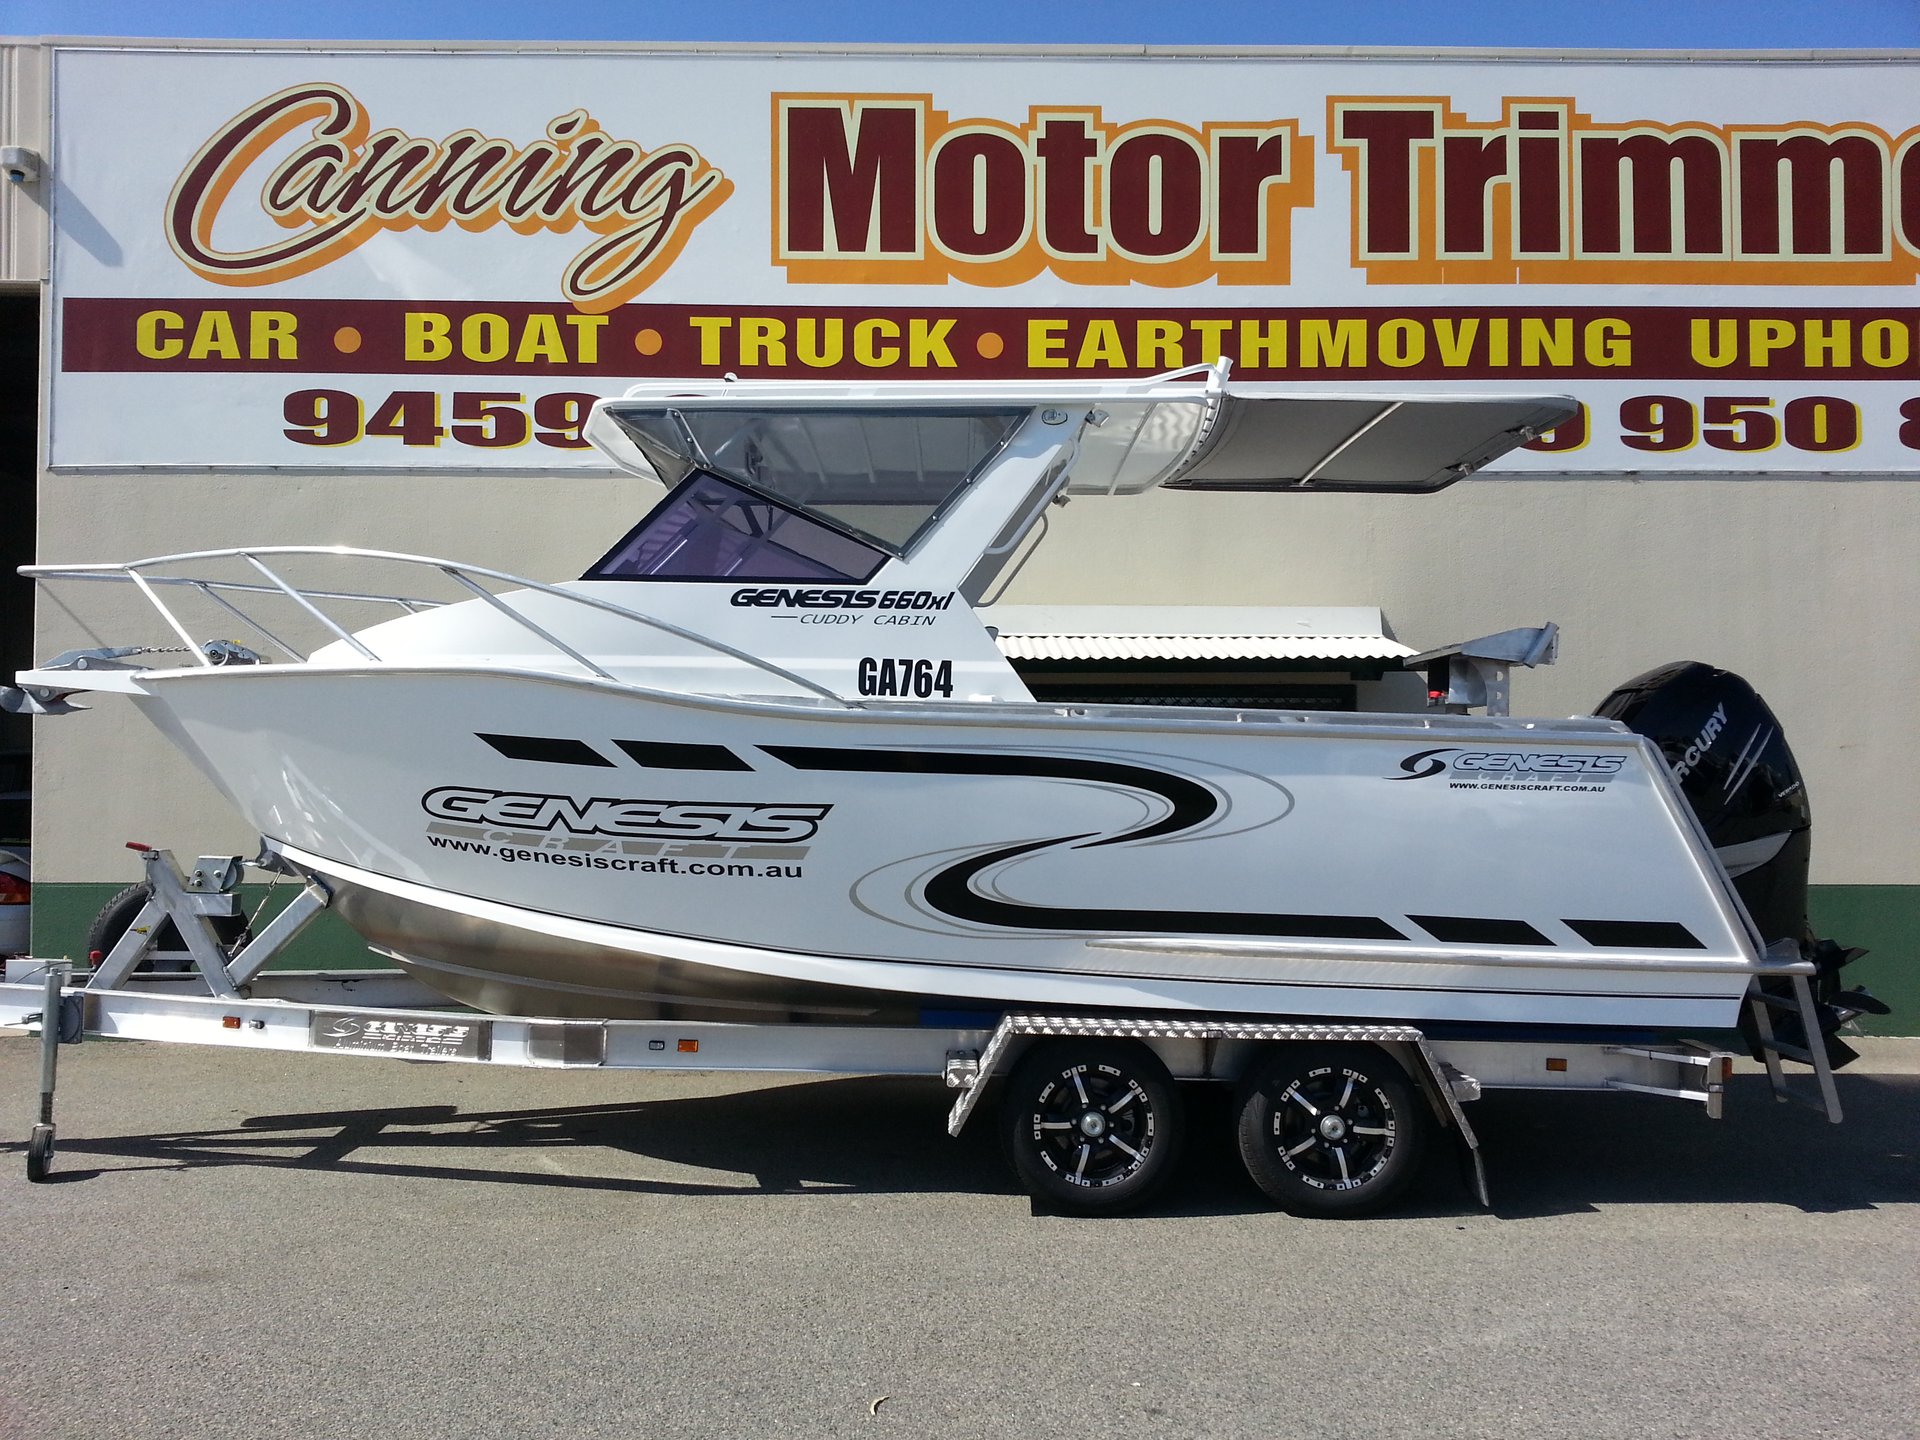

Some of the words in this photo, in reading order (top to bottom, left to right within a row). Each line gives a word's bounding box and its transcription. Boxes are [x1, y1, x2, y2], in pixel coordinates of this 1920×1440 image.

[165, 83, 730, 308] Canning
[778, 99, 1296, 268] Motor
[1333, 102, 1920, 268] Trimm
[136, 310, 298, 360] CAR
[404, 313, 609, 364] BOAT
[689, 316, 957, 369] TRUCK
[1026, 317, 1632, 369] EARTHMOVING
[1690, 319, 1920, 369] UPHO
[1619, 395, 1861, 452] 950
[731, 588, 880, 608] GENESIS
[800, 613, 864, 625] CUDDY
[873, 614, 936, 626] CABIN
[857, 657, 953, 699] GA764
[1452, 752, 1628, 773] GENESIS
[1671, 702, 1728, 785] RCURY
[1449, 782, 1606, 793] WWW.GENESISCRAFT.COM.AU
[421, 785, 834, 843] GENESIS
[426, 835, 803, 879] www.genesiscraft.com.au
